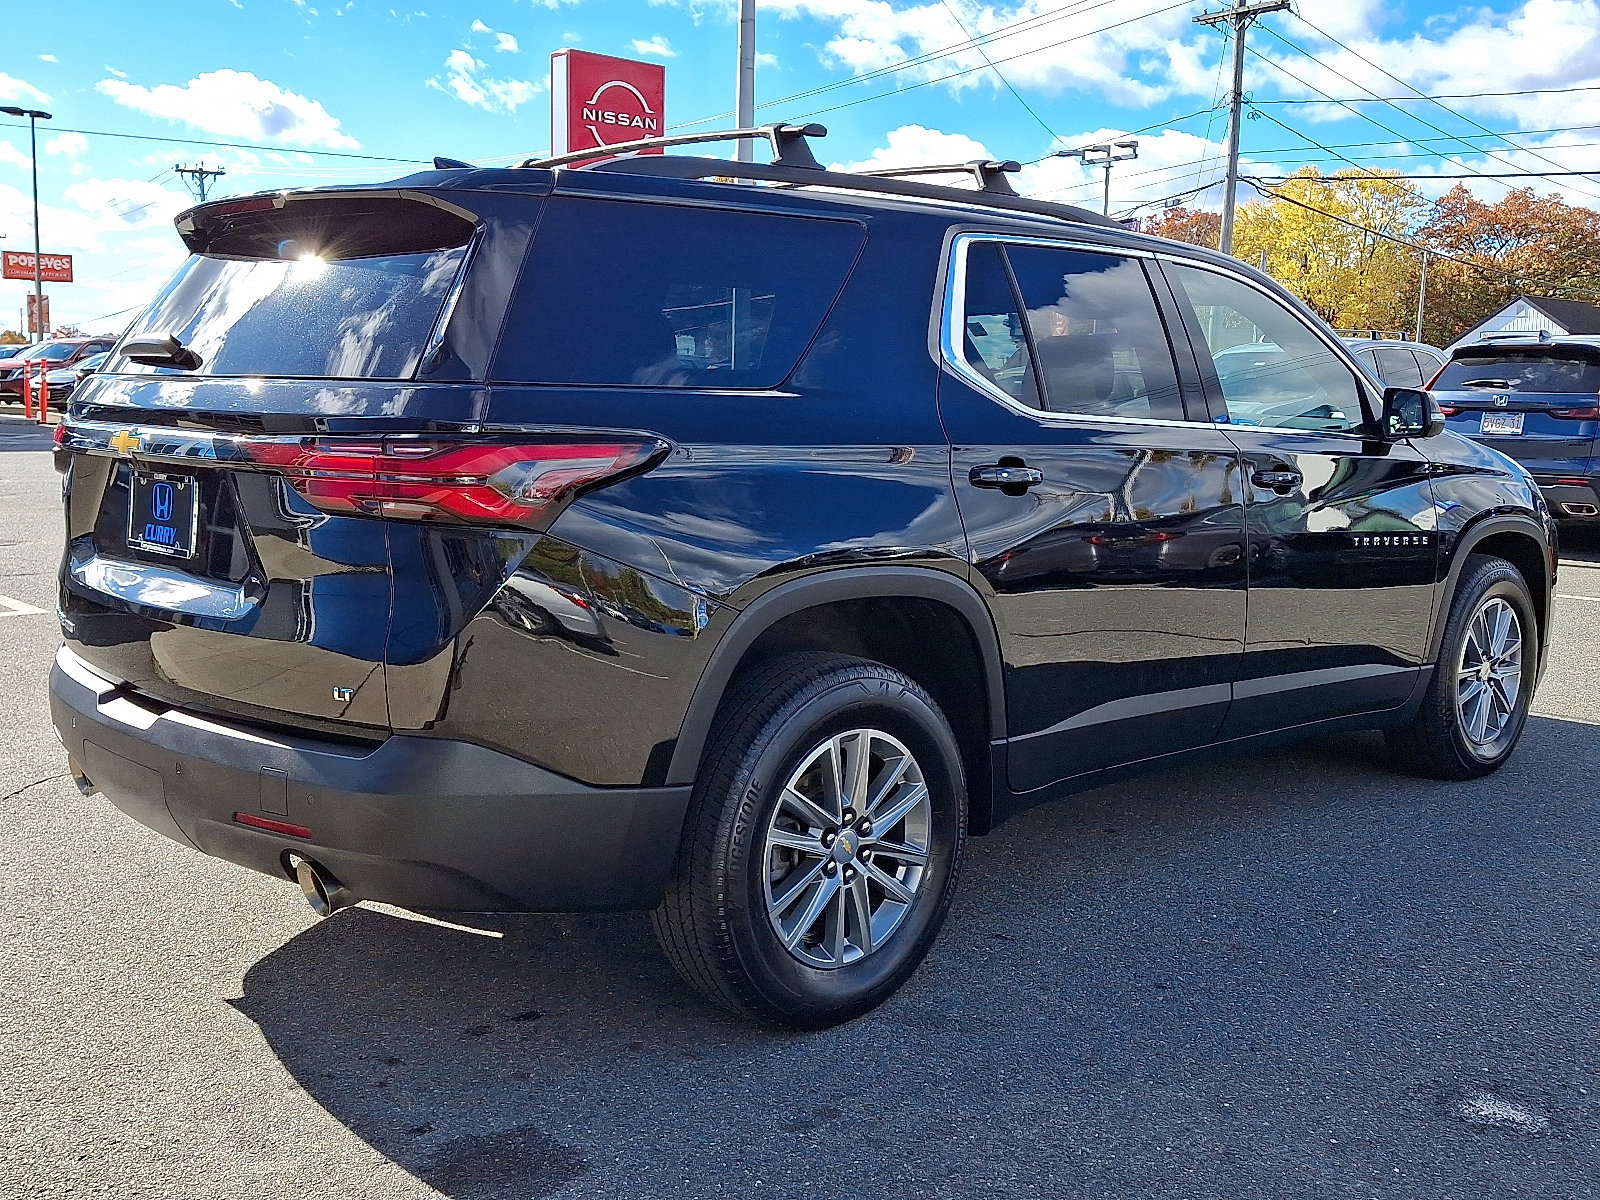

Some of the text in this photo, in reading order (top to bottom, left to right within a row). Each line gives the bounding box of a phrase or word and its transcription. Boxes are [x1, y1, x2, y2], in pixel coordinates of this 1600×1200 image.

[583, 107, 657, 130] NISSAN
[144, 523, 177, 545] CURRY
[1353, 536, 1429, 546] TRAVERSE
[333, 686, 354, 702] LT
